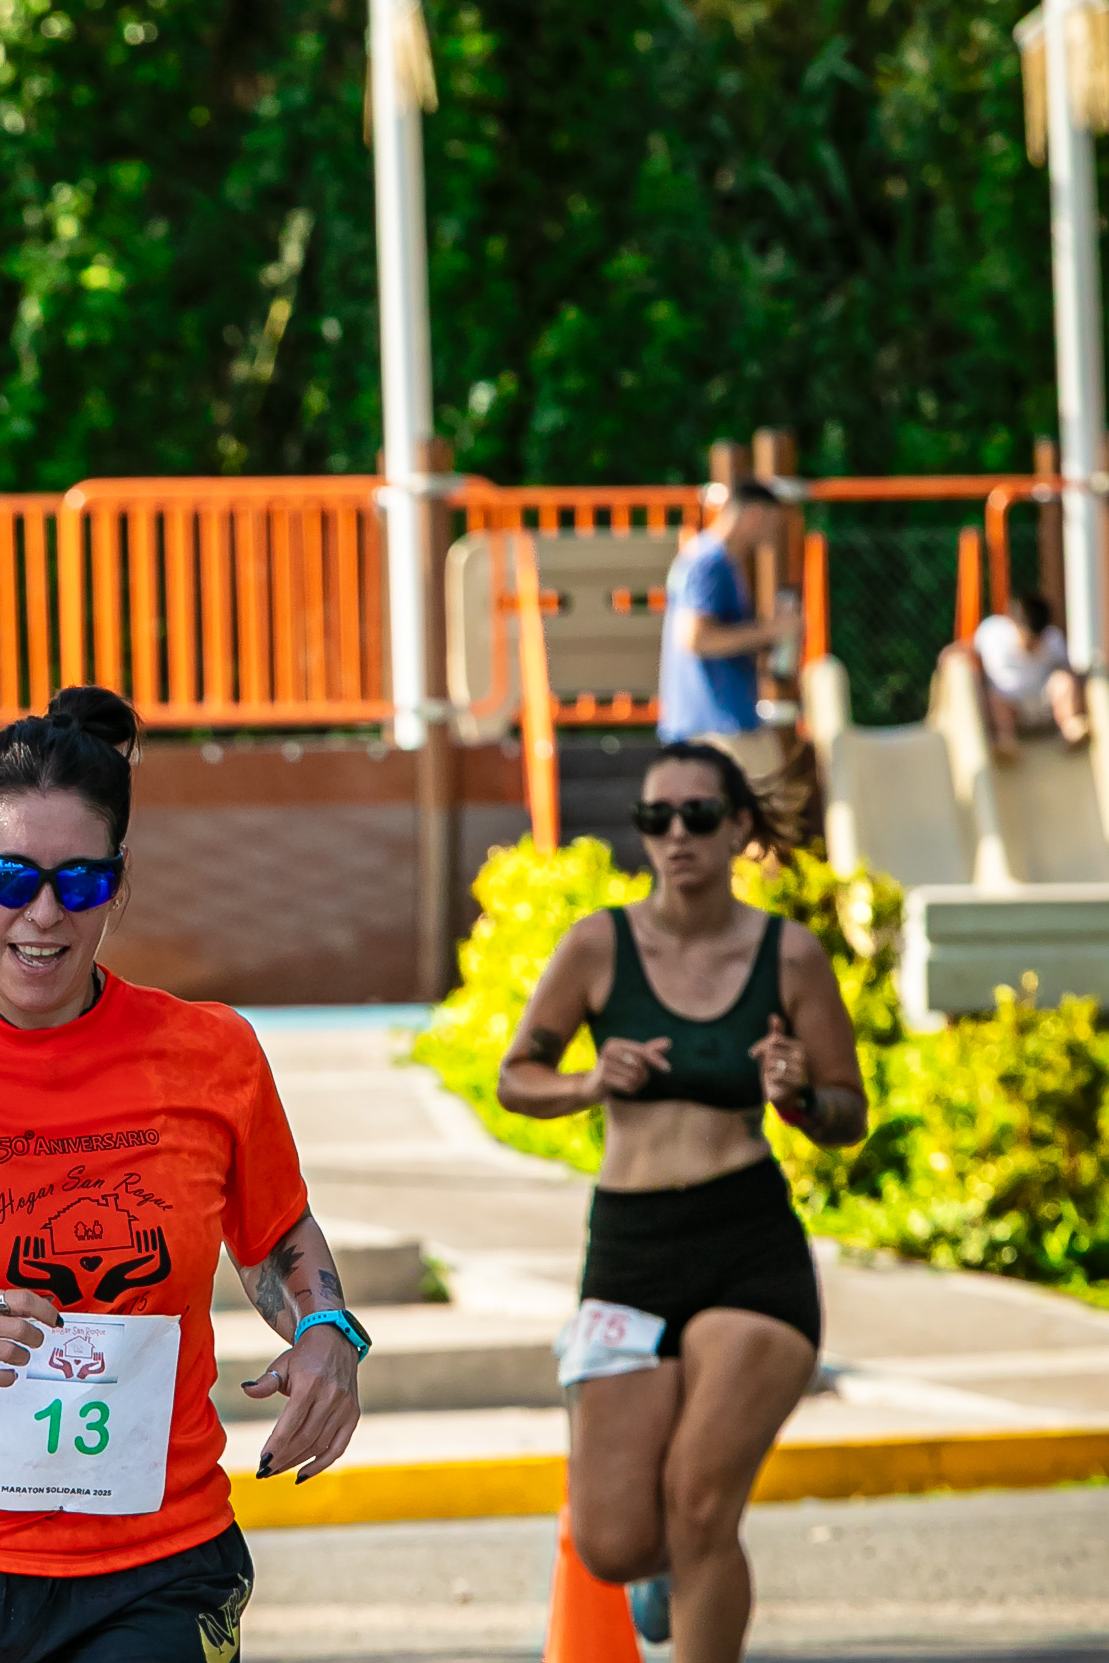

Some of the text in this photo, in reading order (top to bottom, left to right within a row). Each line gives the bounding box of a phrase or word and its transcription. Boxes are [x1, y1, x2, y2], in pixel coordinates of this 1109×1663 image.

[34, 1129, 160, 1156] ANIVERSARIO
[61, 1165, 105, 1191] San
[113, 1173, 173, 1211] Roque
[105, 1291, 150, 1314] 975
[72, 1326, 85, 1336] San
[85, 1326, 106, 1336] Roque
[34, 1398, 110, 1455] 13
[1, 1486, 44, 1494] MARATON
[46, 1487, 91, 1495] SOLIDARIA
